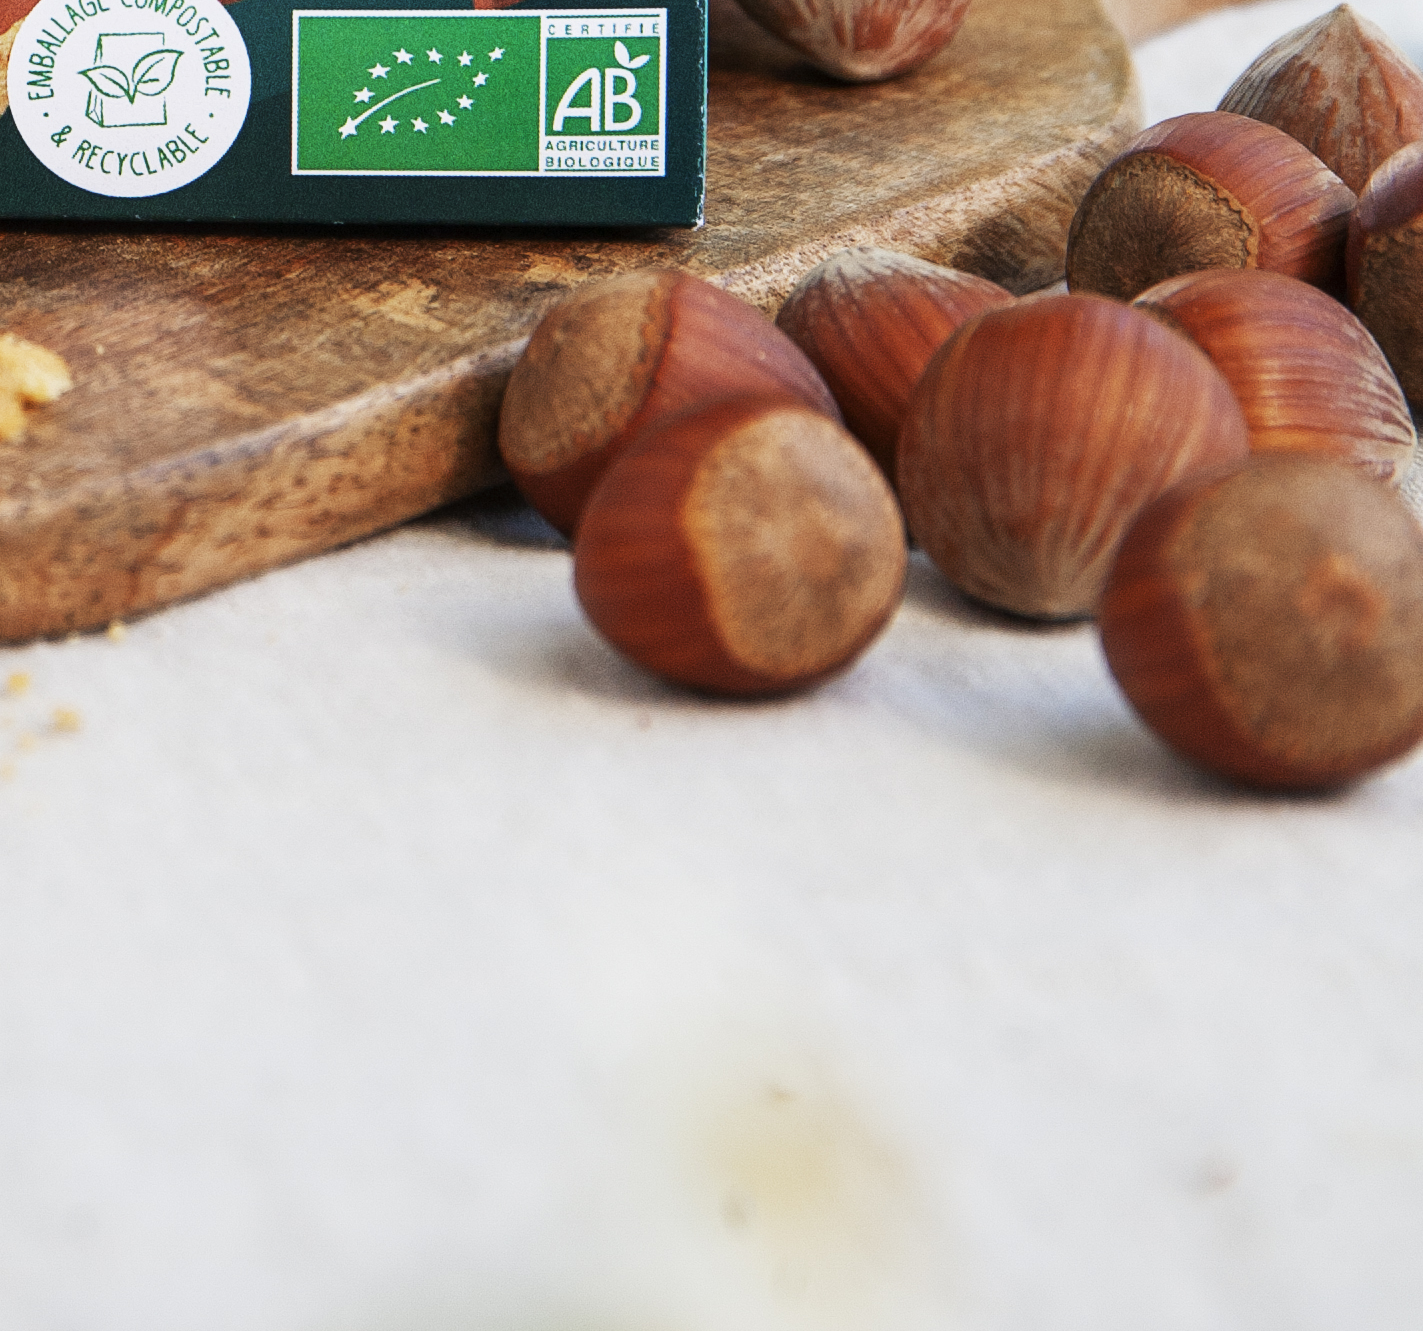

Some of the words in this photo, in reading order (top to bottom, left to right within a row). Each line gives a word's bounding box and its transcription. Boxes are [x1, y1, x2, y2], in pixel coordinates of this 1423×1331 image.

[553, 67, 642, 132] AB
[51, 125, 72, 147] &
[72, 123, 209, 176] RECYCLABLE
[545, 140, 659, 152] AGRICULTURE
[545, 156, 659, 168] BIOLOGIQUE
